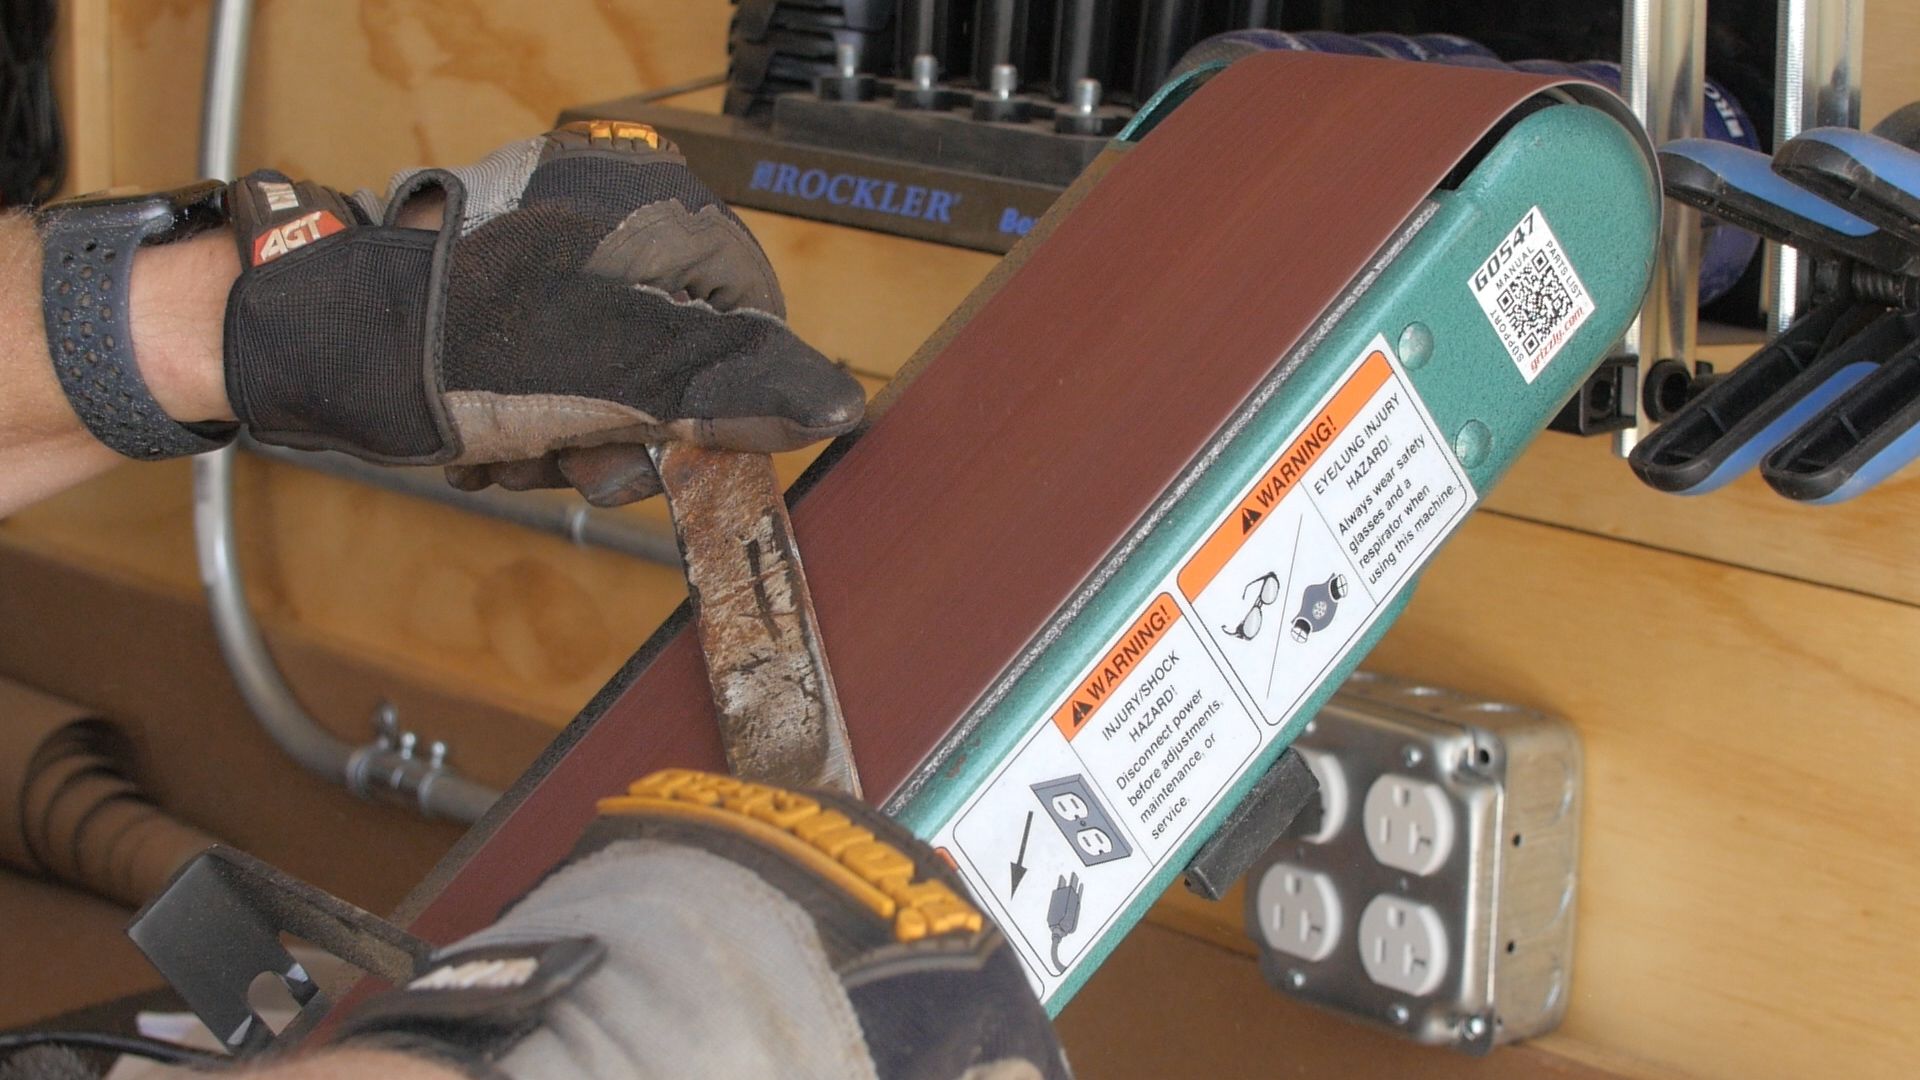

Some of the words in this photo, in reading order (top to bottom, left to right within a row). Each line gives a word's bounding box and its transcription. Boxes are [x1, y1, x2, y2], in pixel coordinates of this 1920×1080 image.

[772, 163, 952, 223] ROCKLER
[1496, 247, 1535, 291] MANUAL
[1546, 240, 1568, 274] PARTS
[1565, 274, 1583, 299] LIST
[1490, 310, 1524, 363] SUPPORT
[1530, 306, 1584, 373] grizzly.com
[1256, 416, 1337, 508] WARNING!
[1314, 435, 1365, 495] EYE/LUNG
[1364, 392, 1400, 438] INJURY
[1346, 435, 1391, 491] HAZARD!
[1338, 494, 1373, 536] Always
[1373, 468, 1396, 496] wear
[1396, 434, 1425, 470] safety
[1349, 509, 1384, 556] glasses
[1385, 485, 1405, 510] and
[1403, 478, 1412, 490] a
[1359, 515, 1403, 569] respirator
[1403, 485, 1430, 516] when
[1368, 552, 1397, 585] using
[1394, 531, 1415, 554] this
[1414, 485, 1457, 532] machine.
[1087, 604, 1171, 701] WARNING!
[1102, 650, 1180, 741] INJURY/SHOCK
[1129, 684, 1177, 743] HAZARD!
[1116, 724, 1174, 791] Disconnect
[1173, 689, 1203, 730] power
[1140, 750, 1206, 824] maintenance,
[1204, 732, 1216, 752] or
[1127, 768, 1161, 808] before
